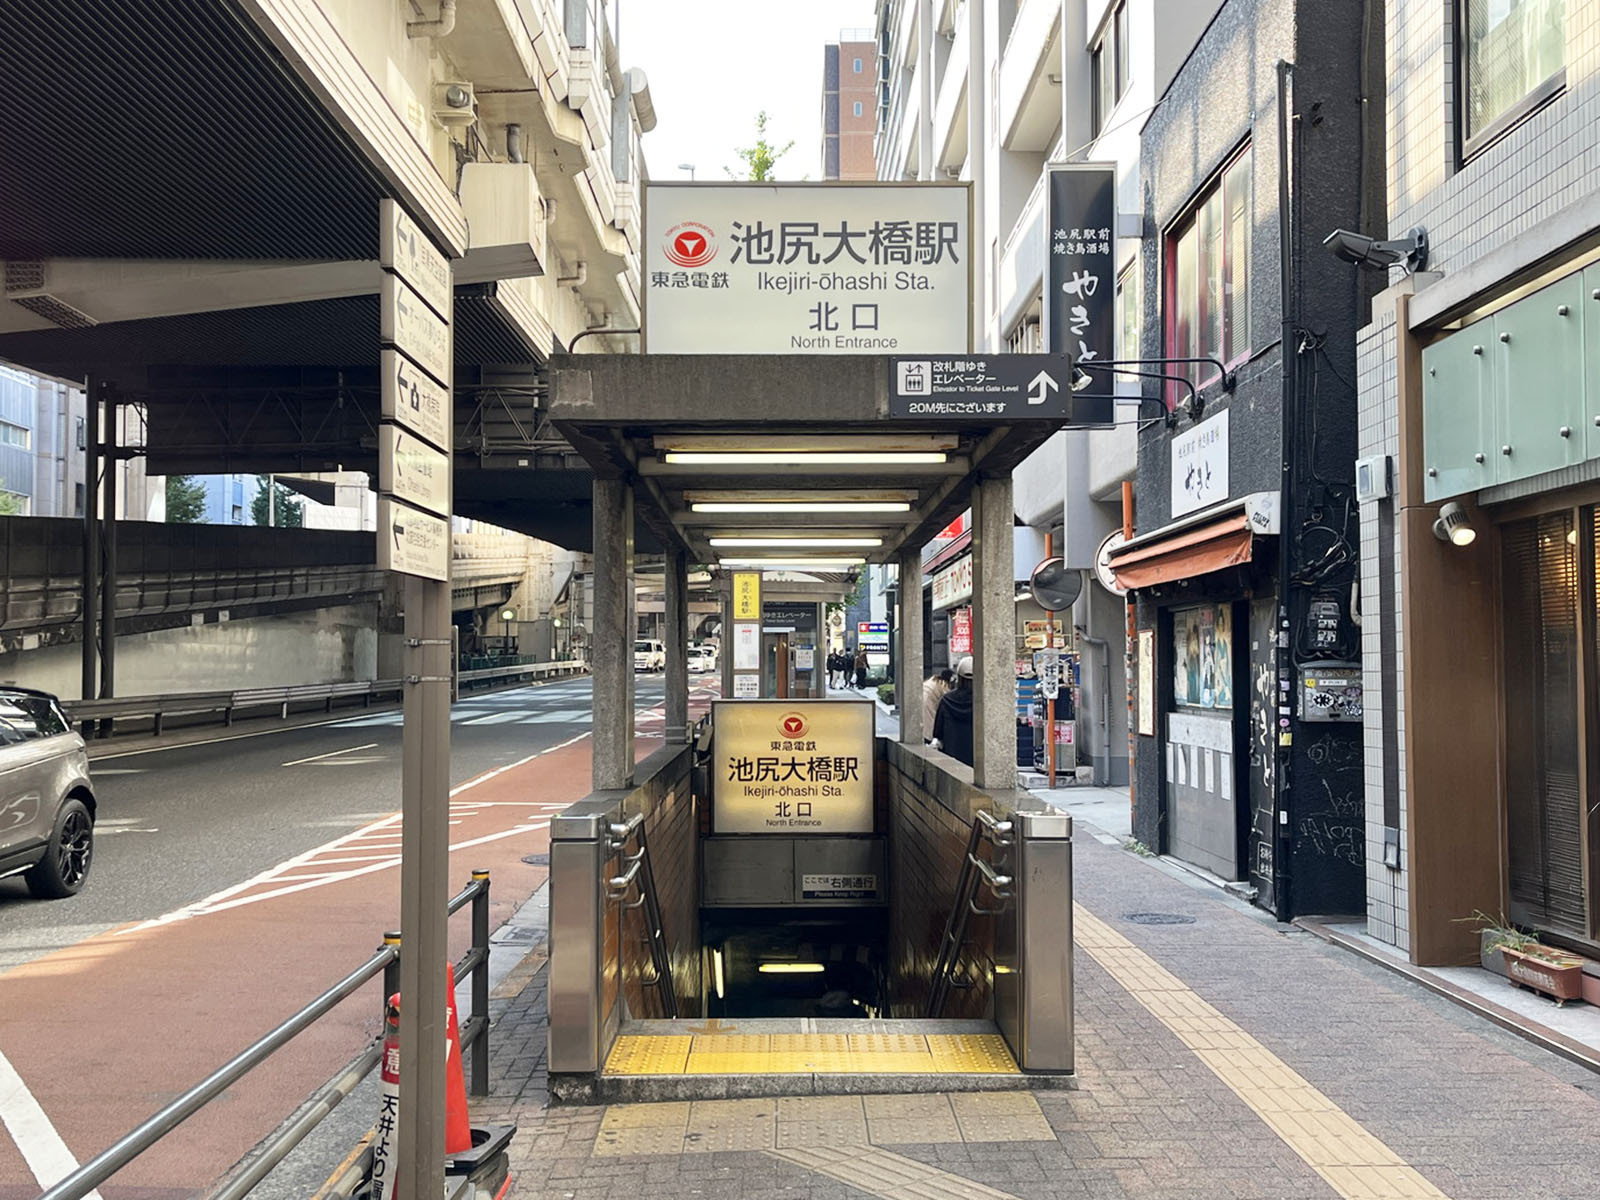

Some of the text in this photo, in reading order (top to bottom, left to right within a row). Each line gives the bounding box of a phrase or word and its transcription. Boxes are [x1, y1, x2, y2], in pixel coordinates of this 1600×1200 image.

[1054, 227, 1111, 241] 池尻駅前
[729, 220, 959, 266] 池尻大橋駅
[1053, 242, 1110, 255] 焼き鳥酒場
[651, 271, 730, 289] 東急電鉄
[757, 271, 936, 295] Ikejiri-ōhashi Sta.
[808, 301, 879, 332] 北口
[791, 335, 898, 348] North Entrance
[932, 361, 987, 372] 改札階ゆき
[933, 375, 997, 384] エレベーター
[908, 402, 1007, 414] 20M先にございます
[770, 741, 817, 751] 東急電鉄
[728, 756, 859, 782] 池尻大橋駅
[821, 785, 845, 797] Sta.
[775, 801, 812, 818] 北口
[766, 819, 822, 827] North Entrance
